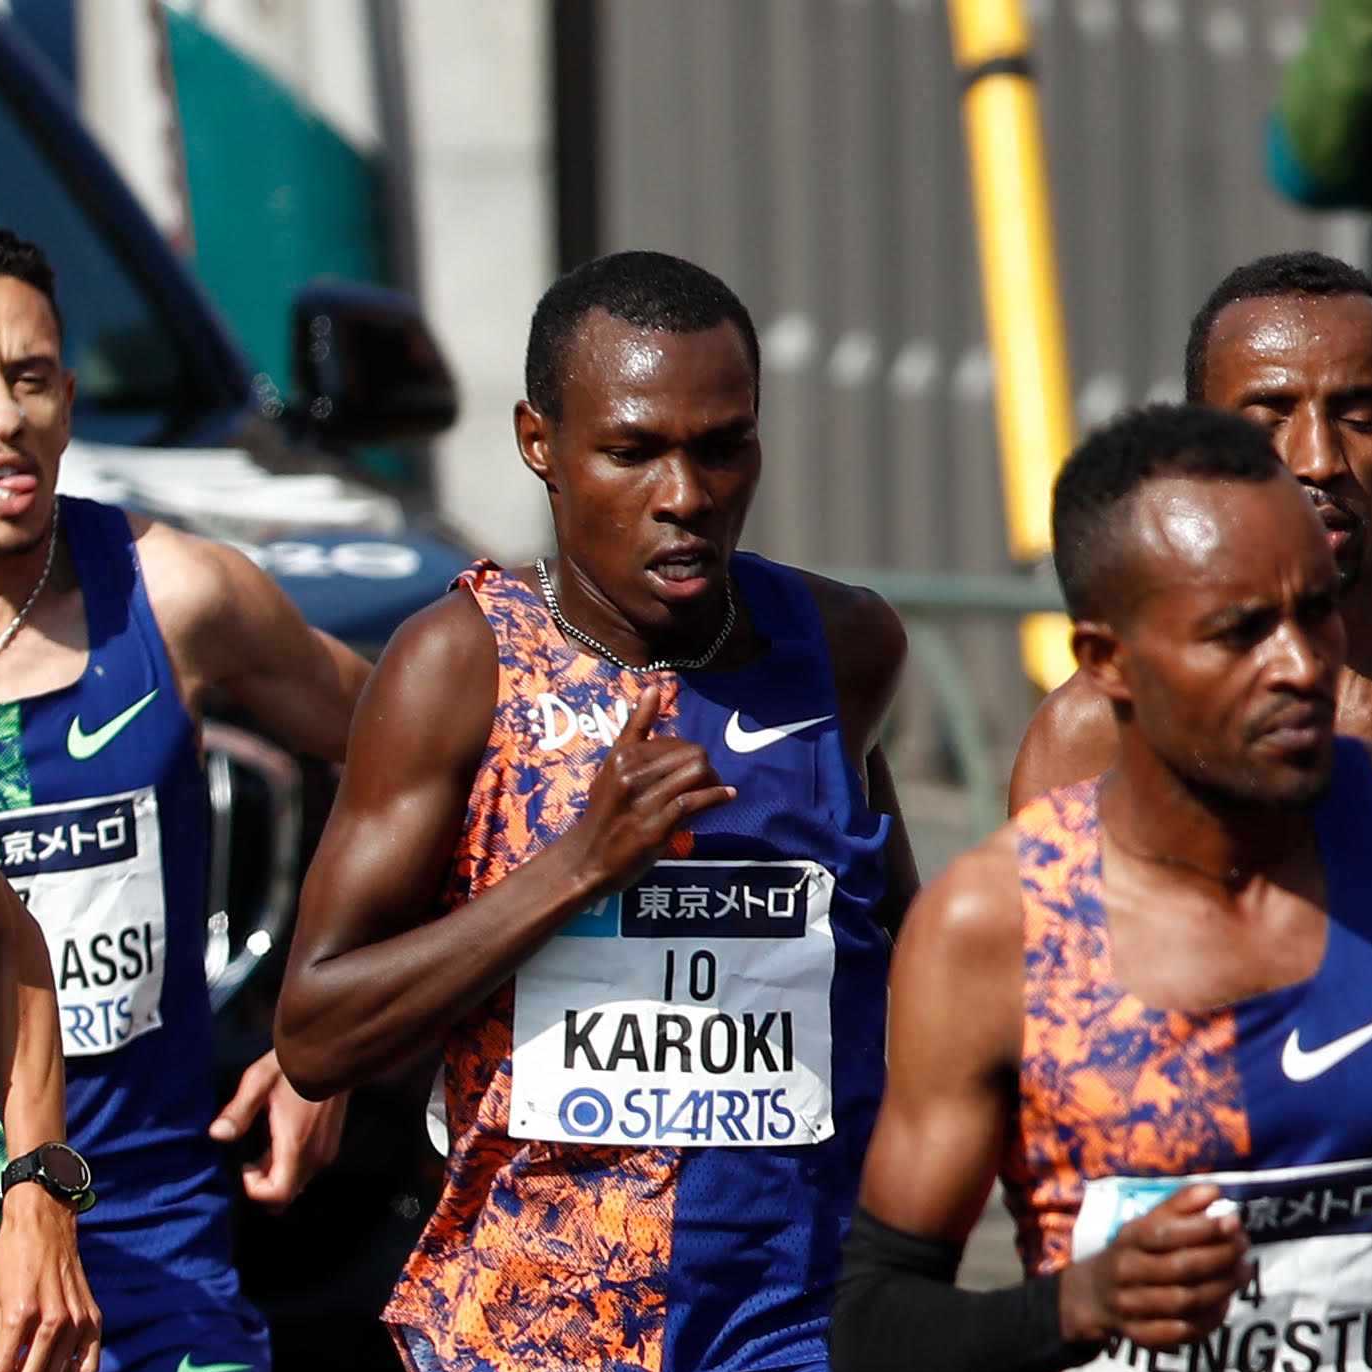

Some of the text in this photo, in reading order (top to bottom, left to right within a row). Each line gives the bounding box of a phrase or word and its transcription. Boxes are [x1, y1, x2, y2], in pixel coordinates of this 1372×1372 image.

[636, 884, 797, 919] 東京メトロ
[58, 921, 154, 990] ASSI
[663, 949, 717, 1002] 10
[564, 1009, 795, 1075] KAROKI
[619, 1087, 796, 1142] STARTS
